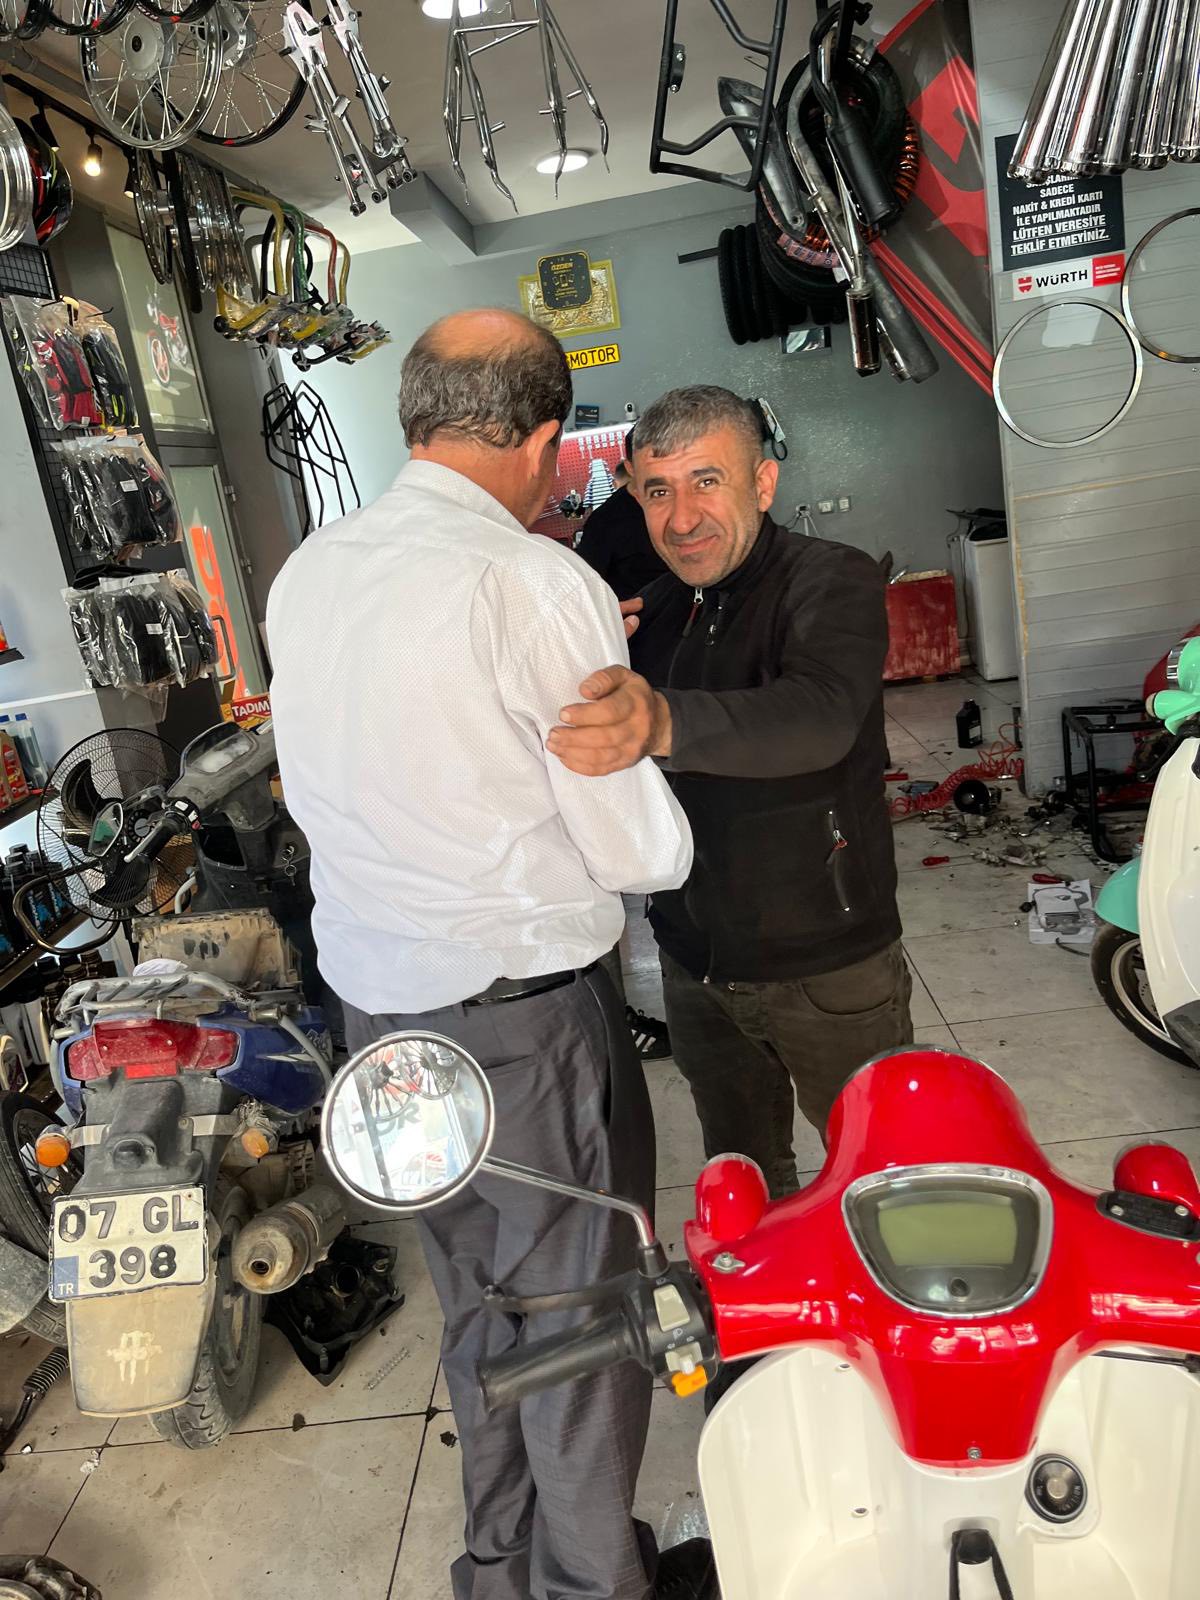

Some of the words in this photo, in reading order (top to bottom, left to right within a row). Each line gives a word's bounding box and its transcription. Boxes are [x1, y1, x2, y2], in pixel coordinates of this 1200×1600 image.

[1013, 201, 1038, 215] NAKİT
[1040, 201, 1048, 210] &
[1049, 194, 1075, 209] KREDİ
[1077, 190, 1103, 201] KARTI
[1040, 184, 1074, 198] SADECE
[1016, 215, 1031, 227] İLE
[1031, 203, 1101, 224] YAPILMAKTADIR
[1012, 223, 1052, 241] LÜTFEN
[1055, 214, 1106, 233] VERESİYE
[1010, 239, 1046, 256] TEKLİF
[1048, 228, 1110, 249] ETMEYİNİZ.
[1036, 269, 1088, 288] WÜRTH
[569, 347, 616, 368] MOTOR
[232, 700, 270, 717] TADIM
[58, 1201, 117, 1243] 07
[142, 1194, 199, 1234] GL
[88, 1243, 177, 1289] 398
[57, 1283, 75, 1296] TR
